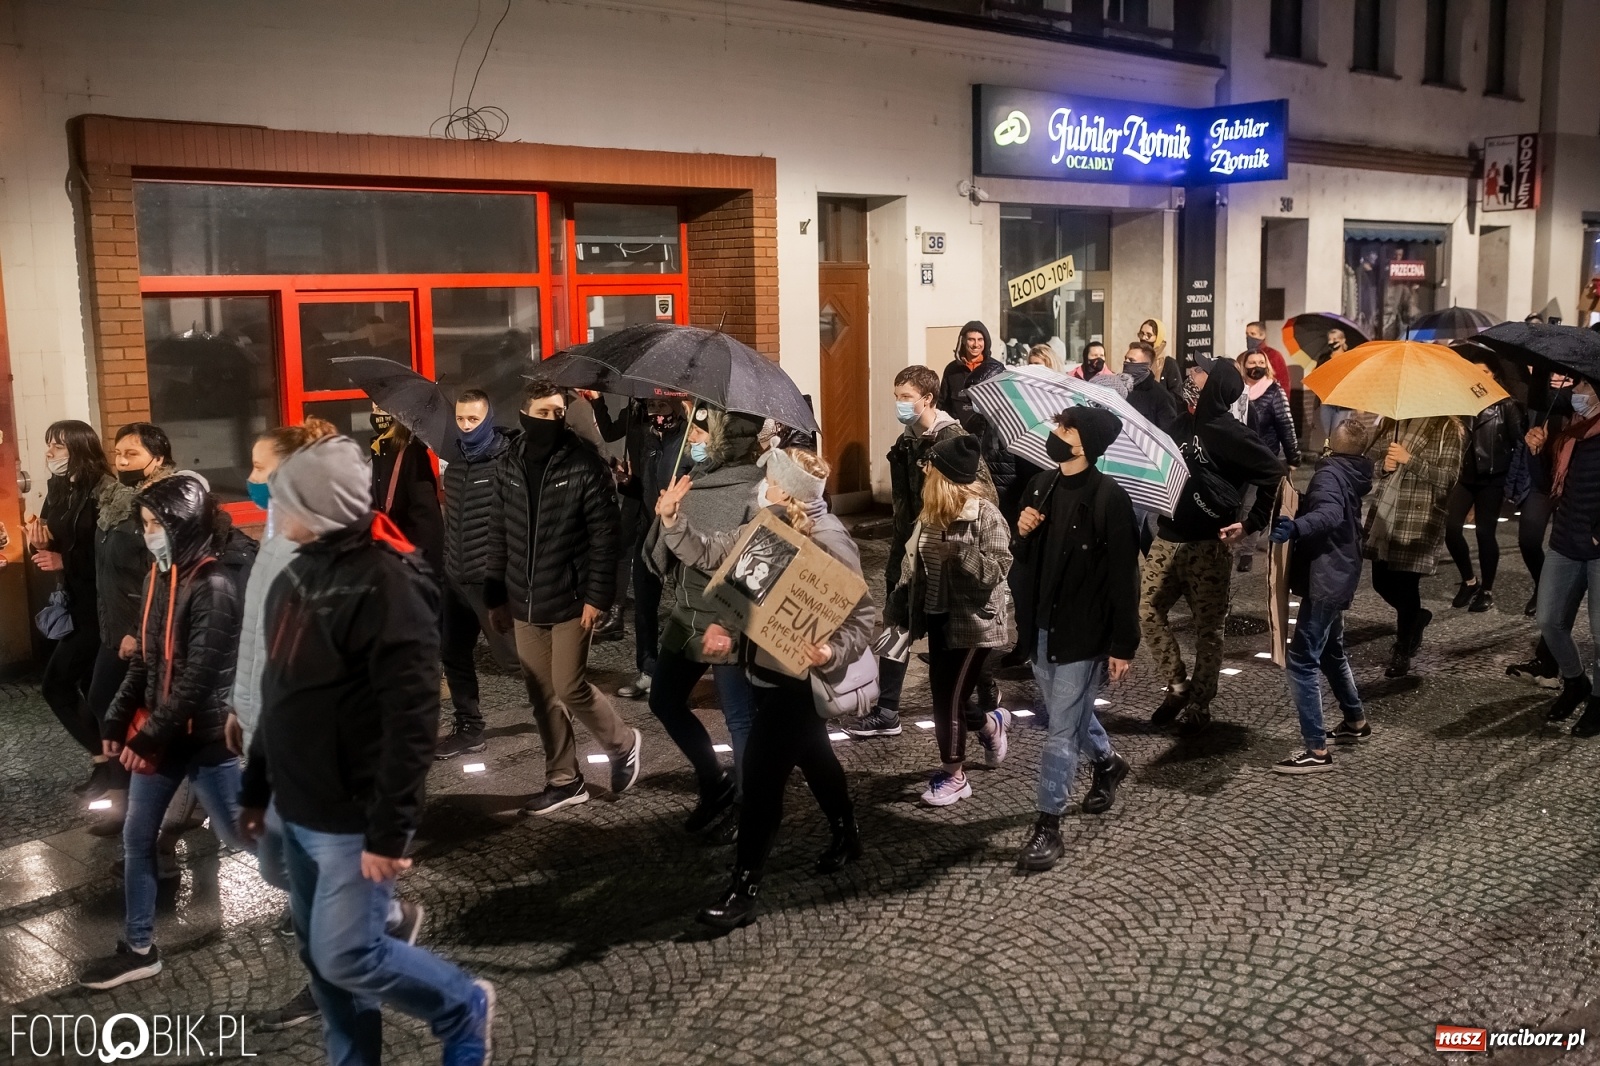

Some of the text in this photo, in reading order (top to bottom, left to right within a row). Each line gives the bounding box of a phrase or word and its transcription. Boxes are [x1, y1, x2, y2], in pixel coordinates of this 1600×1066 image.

[1048, 107, 1191, 164] Jubiler Złotnik
[1210, 118, 1269, 149] Jubiler
[1210, 149, 1270, 175] Złotnik
[929, 236, 944, 249] 36
[922, 270, 933, 281] 36
[1011, 260, 1074, 302] ZŁOTO -10%
[1390, 263, 1425, 277] PRZECENA
[799, 569, 854, 611] GIRLS JUST
[775, 596, 833, 646] FUN
[760, 625, 806, 666] RIGHTS
